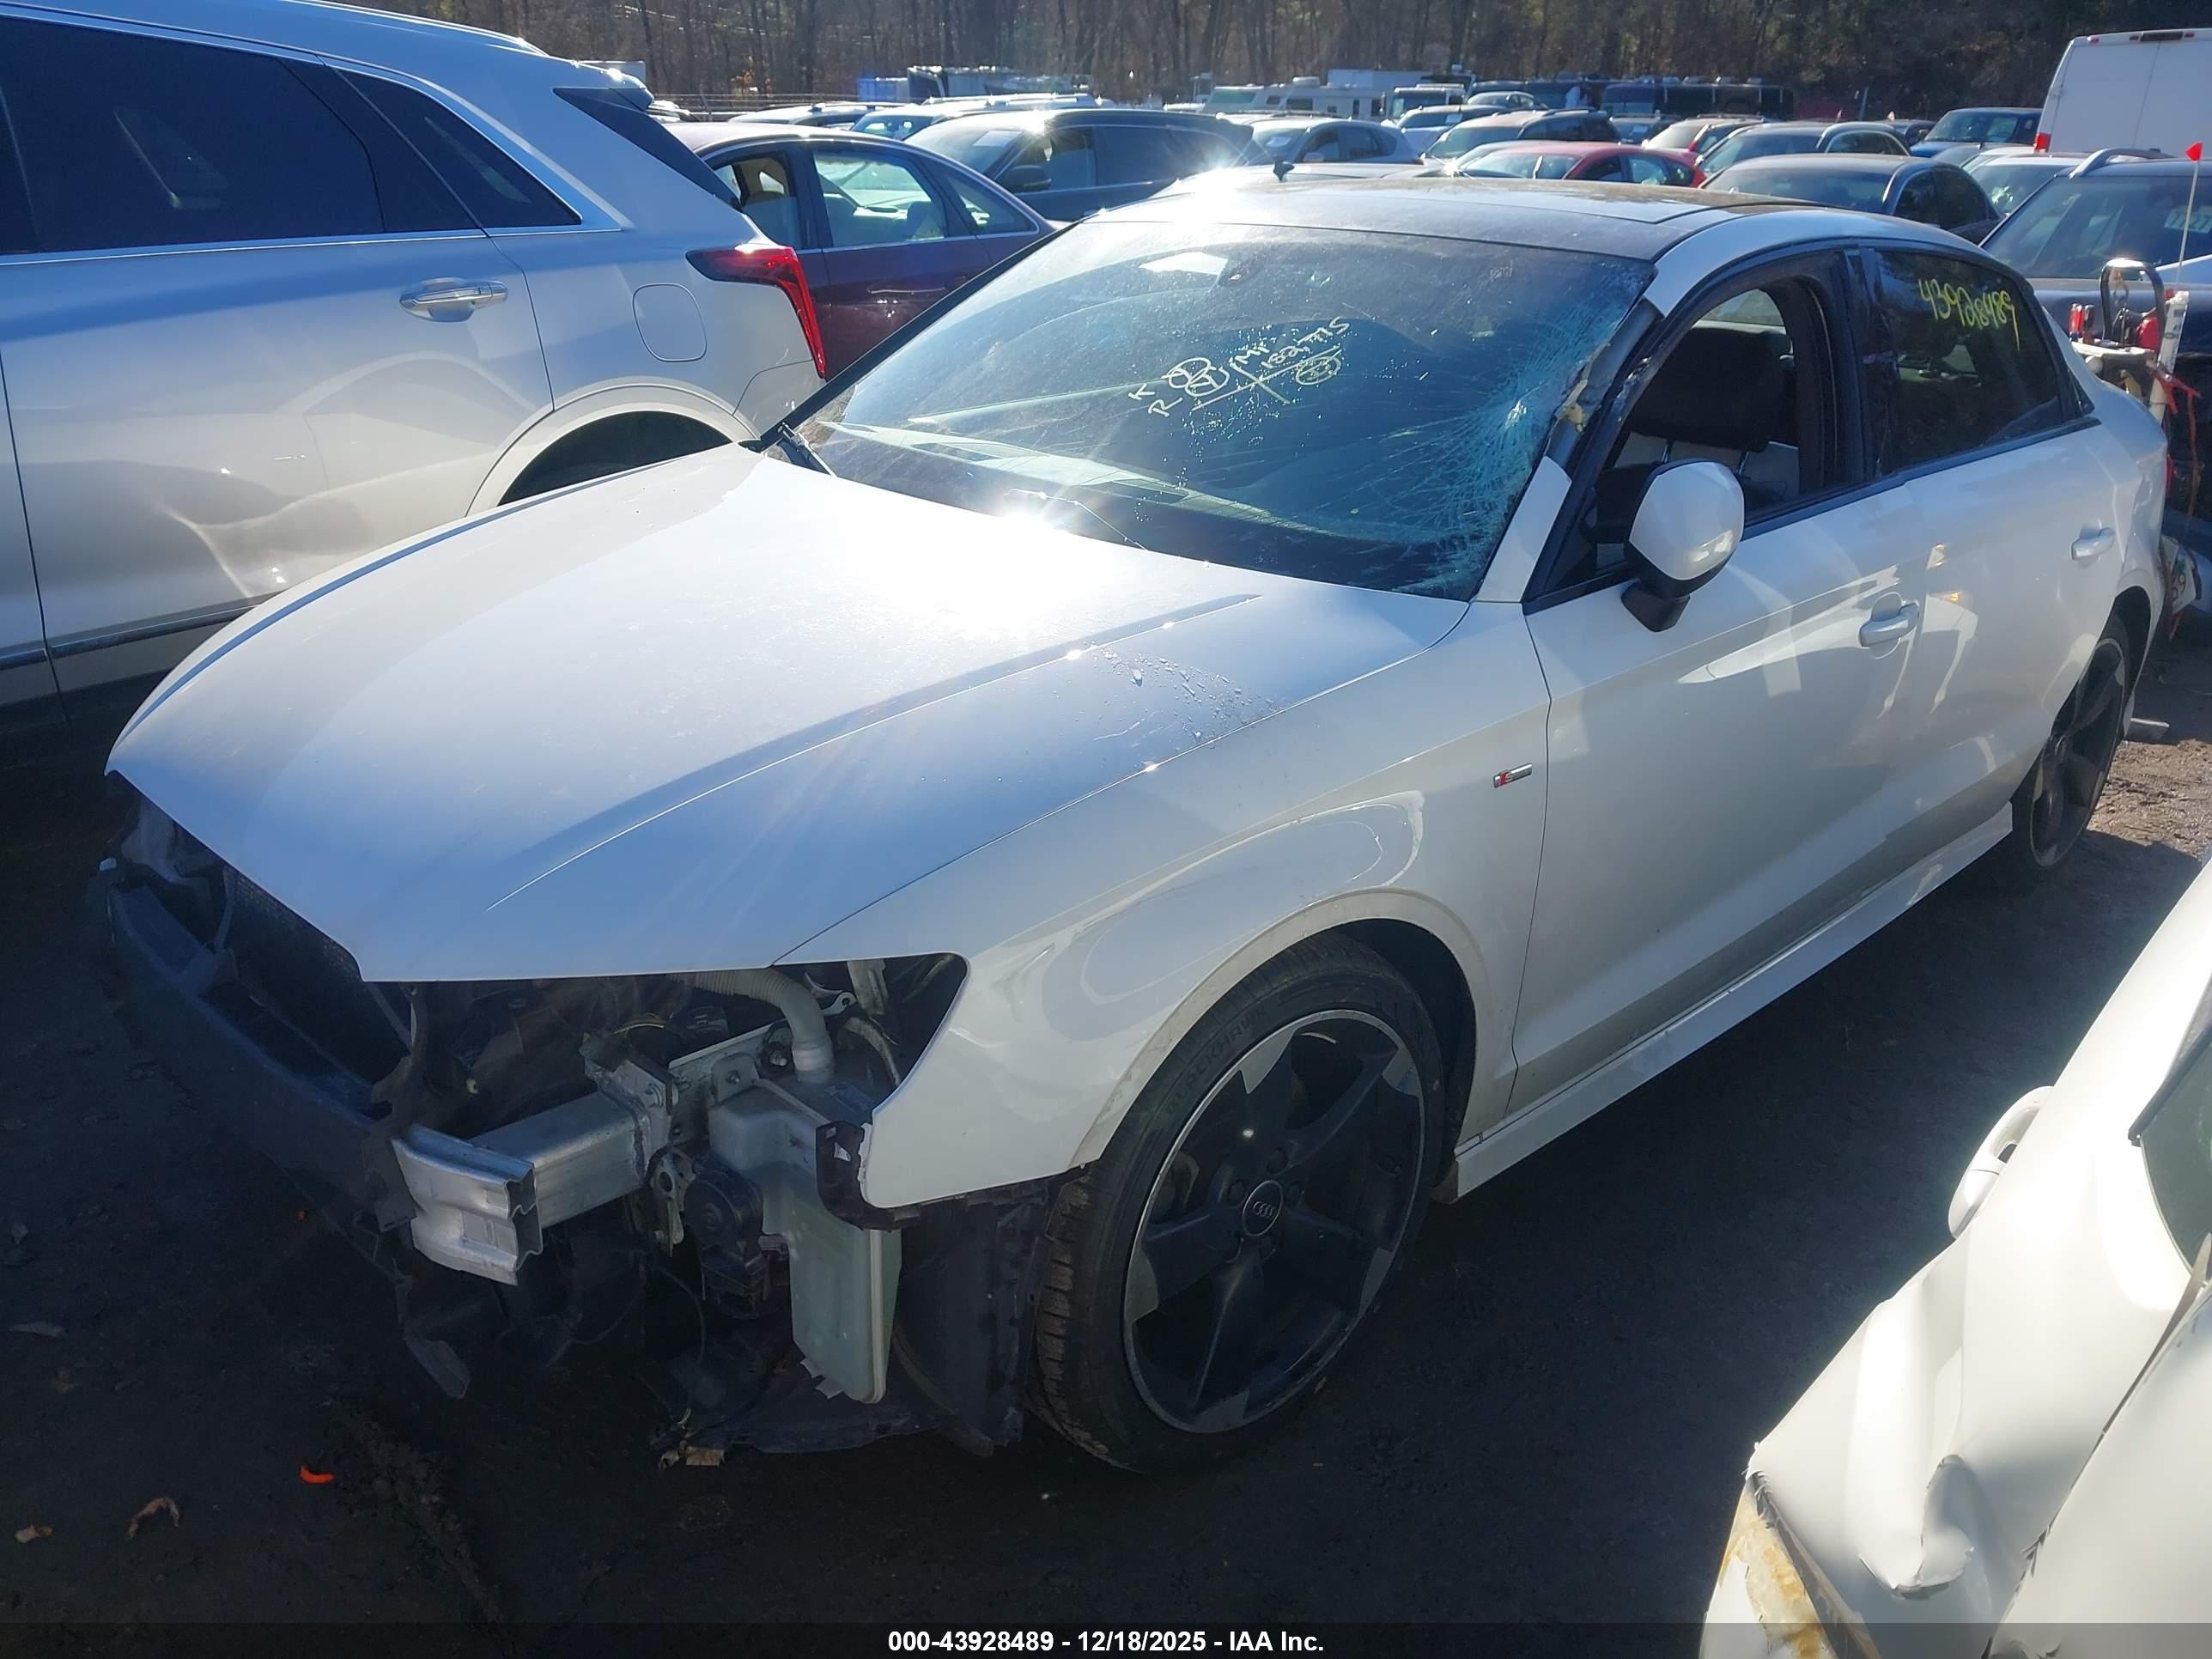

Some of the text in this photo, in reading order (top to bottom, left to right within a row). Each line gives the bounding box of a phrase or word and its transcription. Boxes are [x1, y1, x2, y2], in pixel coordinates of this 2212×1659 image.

[1917, 277, 2020, 351] 43928489
[1147, 397, 1183, 417] R
[1164, 1004, 1269, 1116] BLACKHAWK
